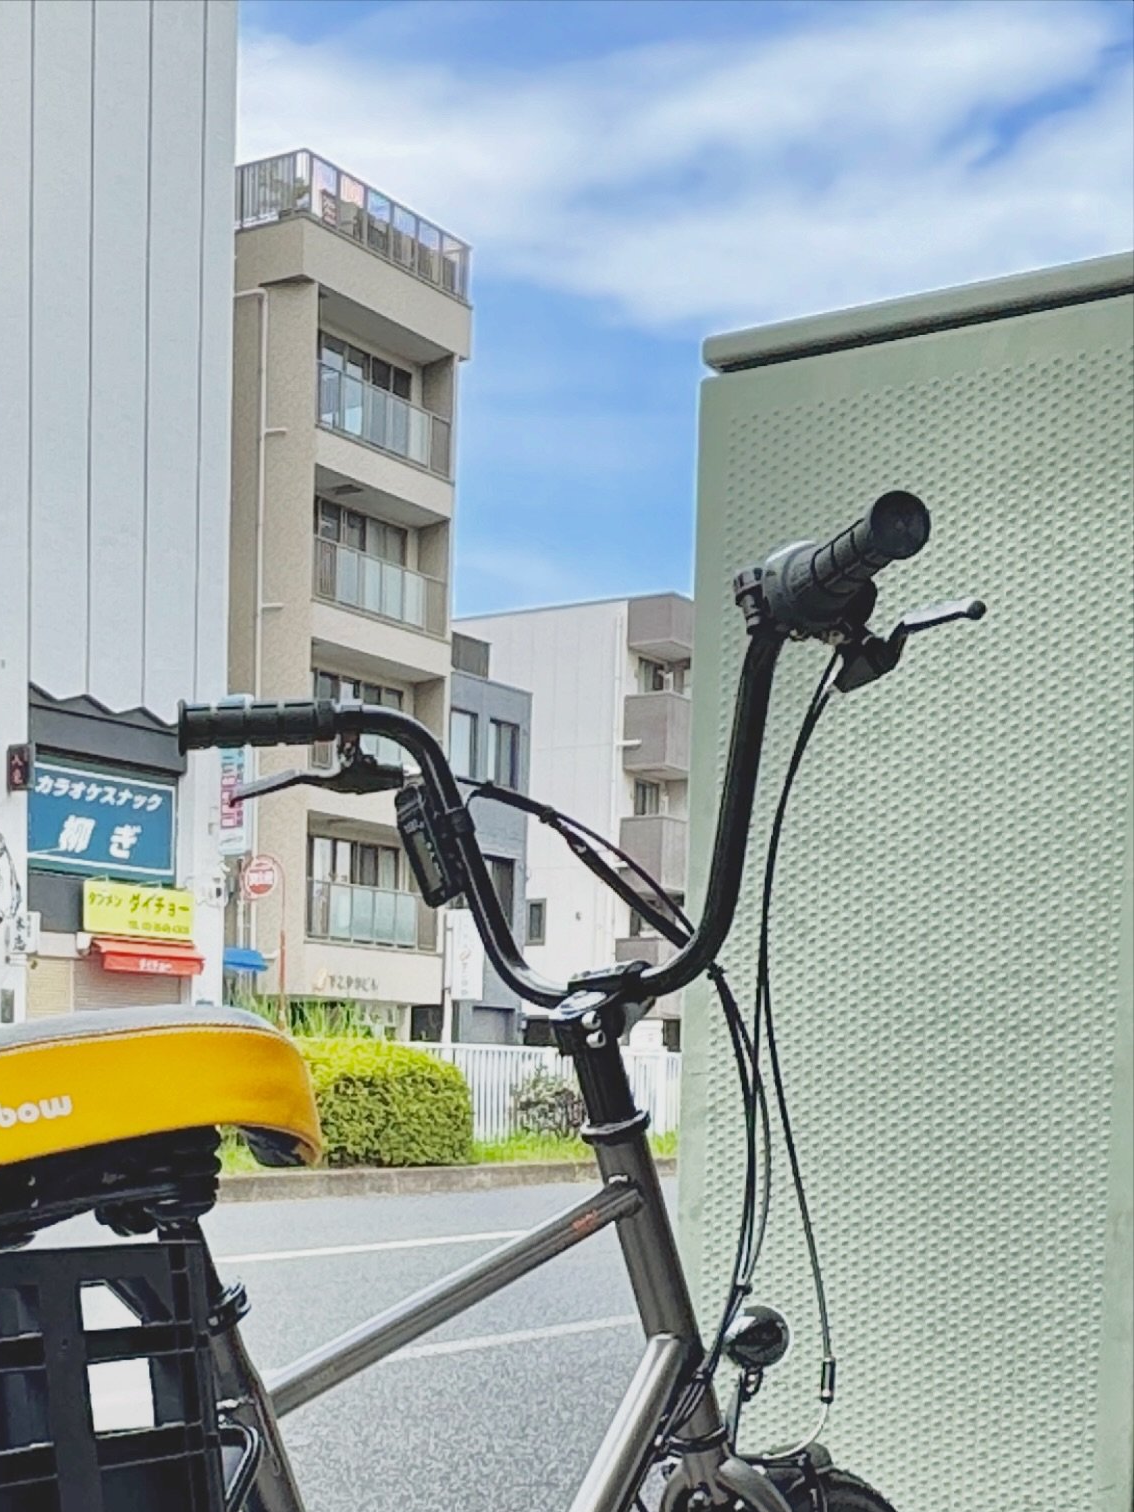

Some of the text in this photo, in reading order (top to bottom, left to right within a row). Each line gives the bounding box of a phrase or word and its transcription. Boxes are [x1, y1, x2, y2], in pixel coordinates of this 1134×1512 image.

[34, 775, 163, 812] カラオケスナック
